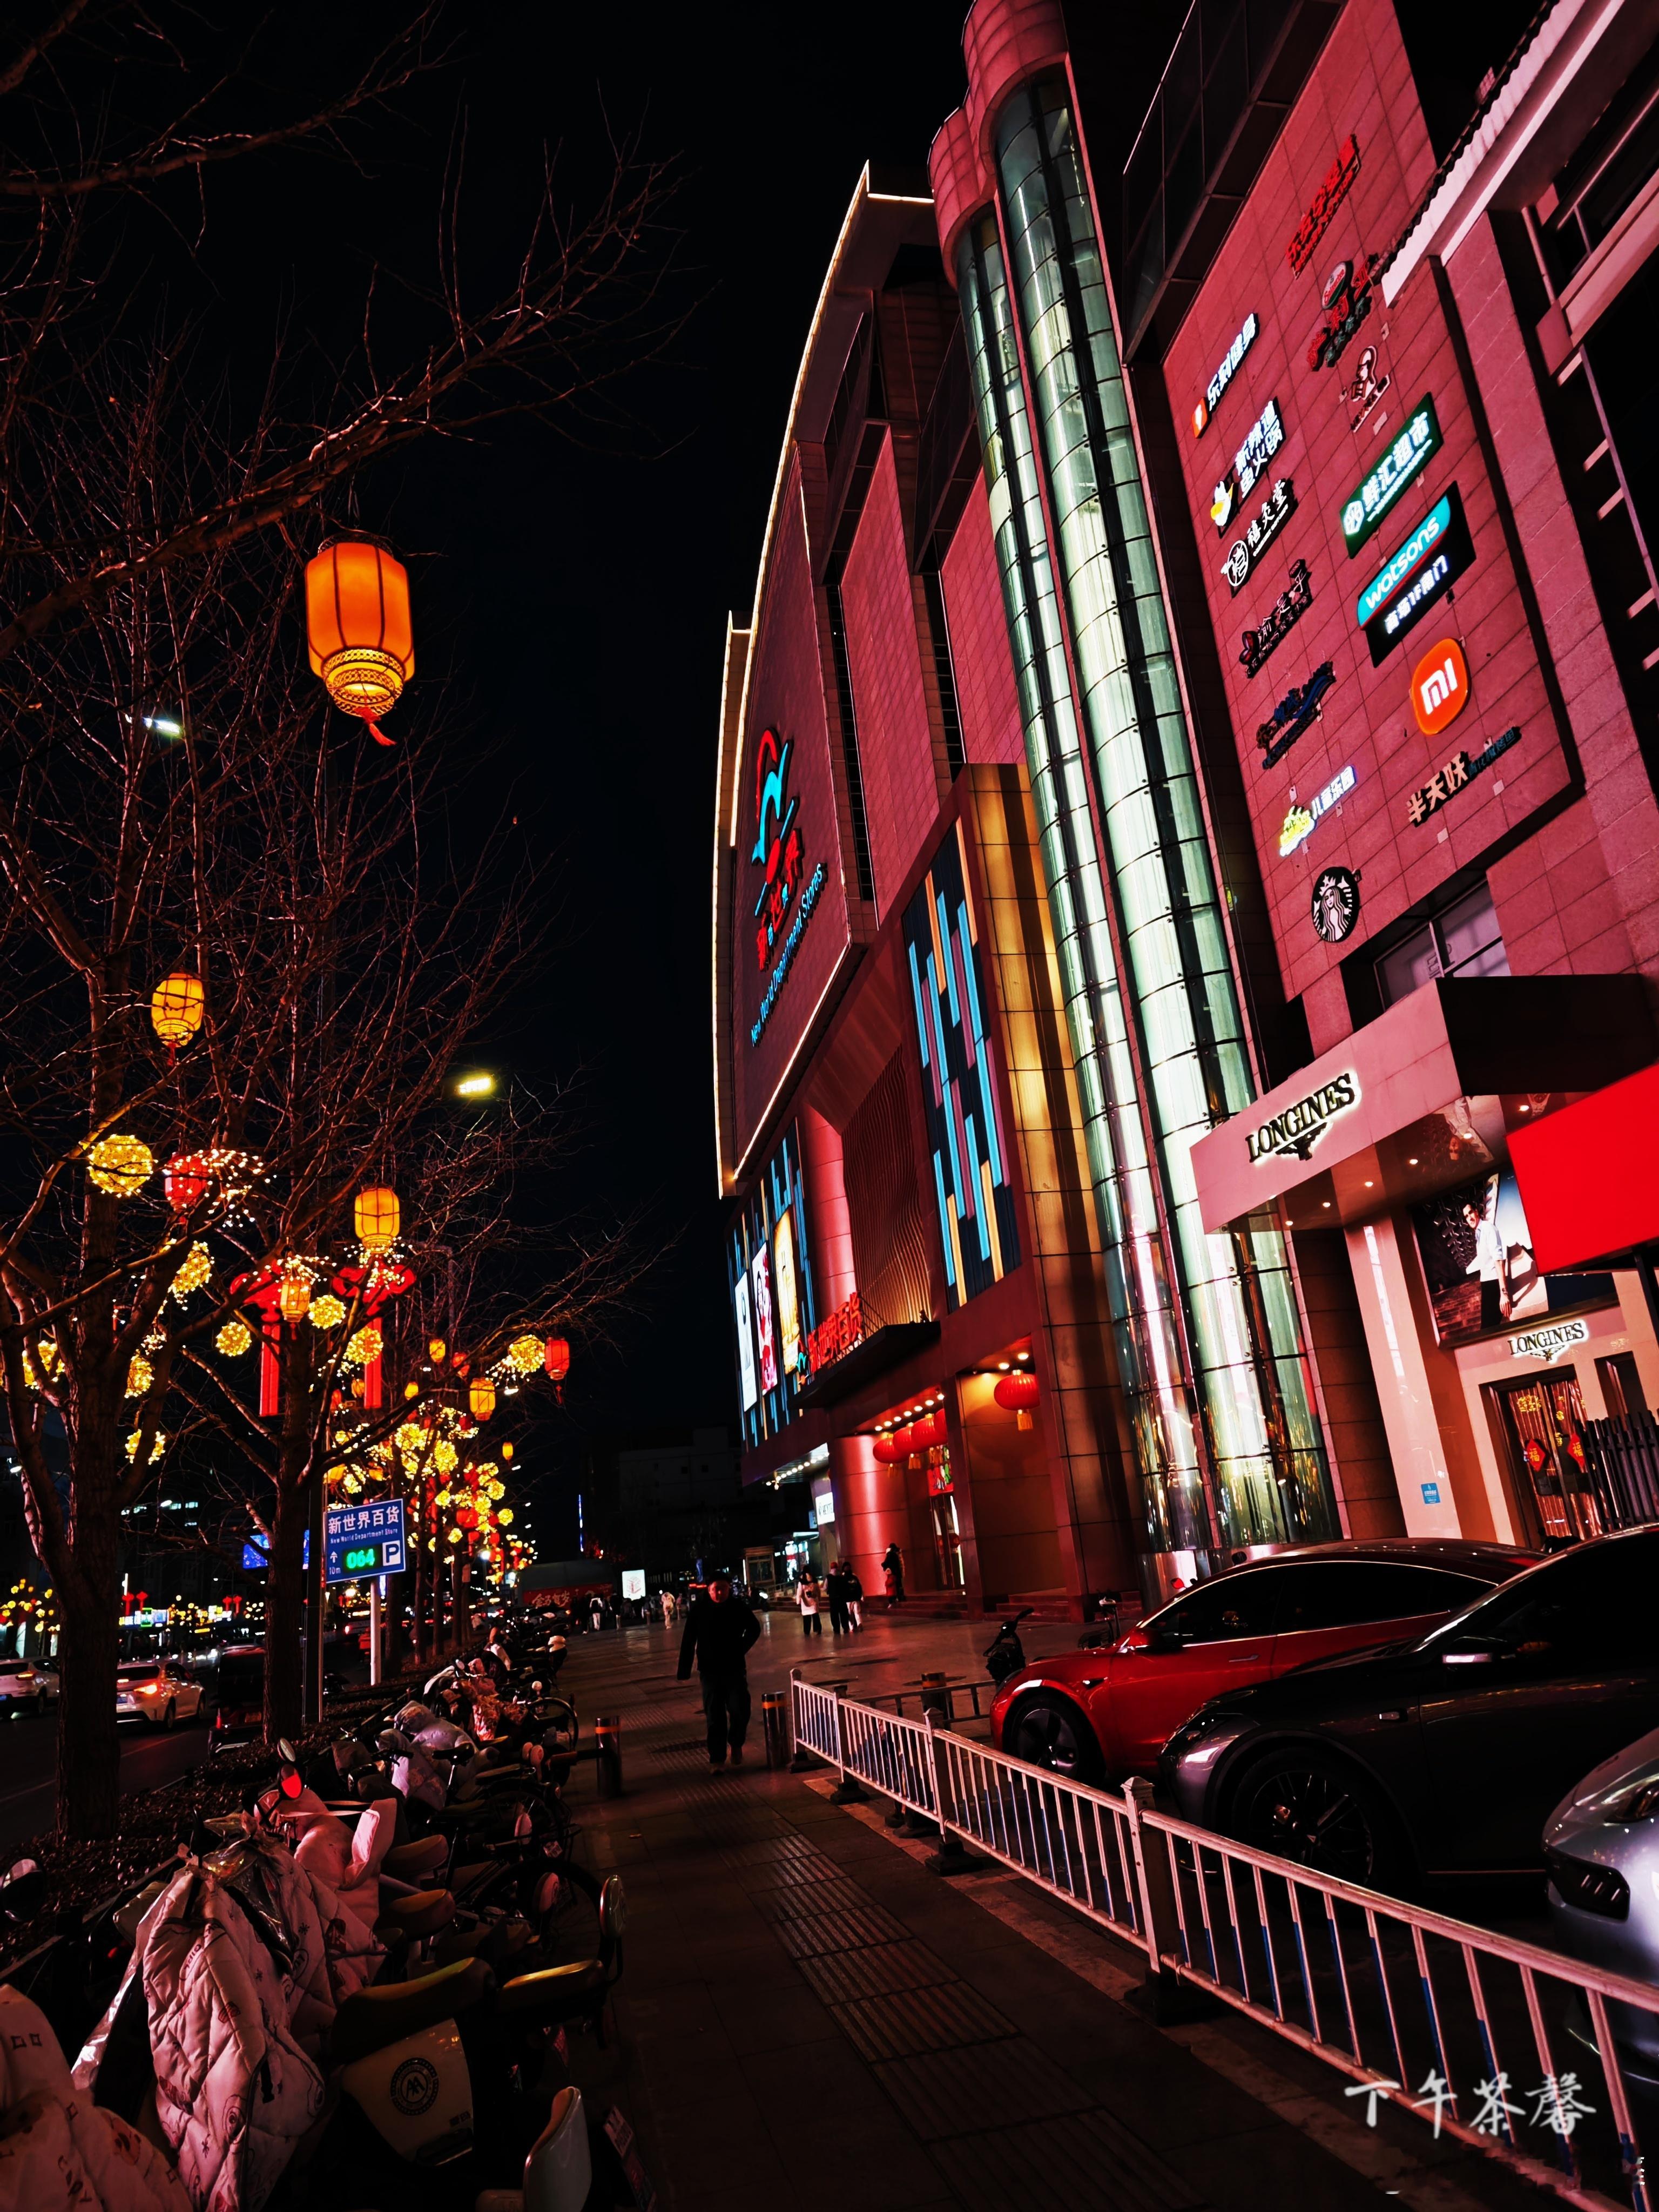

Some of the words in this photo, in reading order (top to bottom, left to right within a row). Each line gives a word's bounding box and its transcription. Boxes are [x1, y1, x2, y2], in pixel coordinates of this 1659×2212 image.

[1207, 313, 1256, 412] 乐刻健身
[1235, 400, 1278, 476] 新辣道
[1240, 415, 1283, 498] 鱼火锅
[1361, 412, 1429, 515] 鲜汇超市
[1365, 515, 1439, 609] watsons
[1384, 555, 1448, 634] 商场1F南门
[1311, 765, 1355, 819] 儿童乐园
[751, 1019, 761, 1046] New
[760, 980, 775, 1022] World
[773, 909, 802, 992] Department
[801, 863, 822, 918] Stores
[1245, 1073, 1357, 1163] LONGINES
[807, 1291, 864, 1373] 新世界百货
[1509, 1322, 1586, 1357] LONGINES
[1528, 1447, 1540, 1461] 福
[1572, 1441, 1584, 1456] 福
[328, 1506, 400, 1534] 新世界百货
[340, 1534, 354, 1542] World
[354, 1529, 384, 1540] Department
[328, 1566, 341, 1575] 10m
[346, 1548, 375, 1569] 064
[386, 1543, 399, 1563] P
